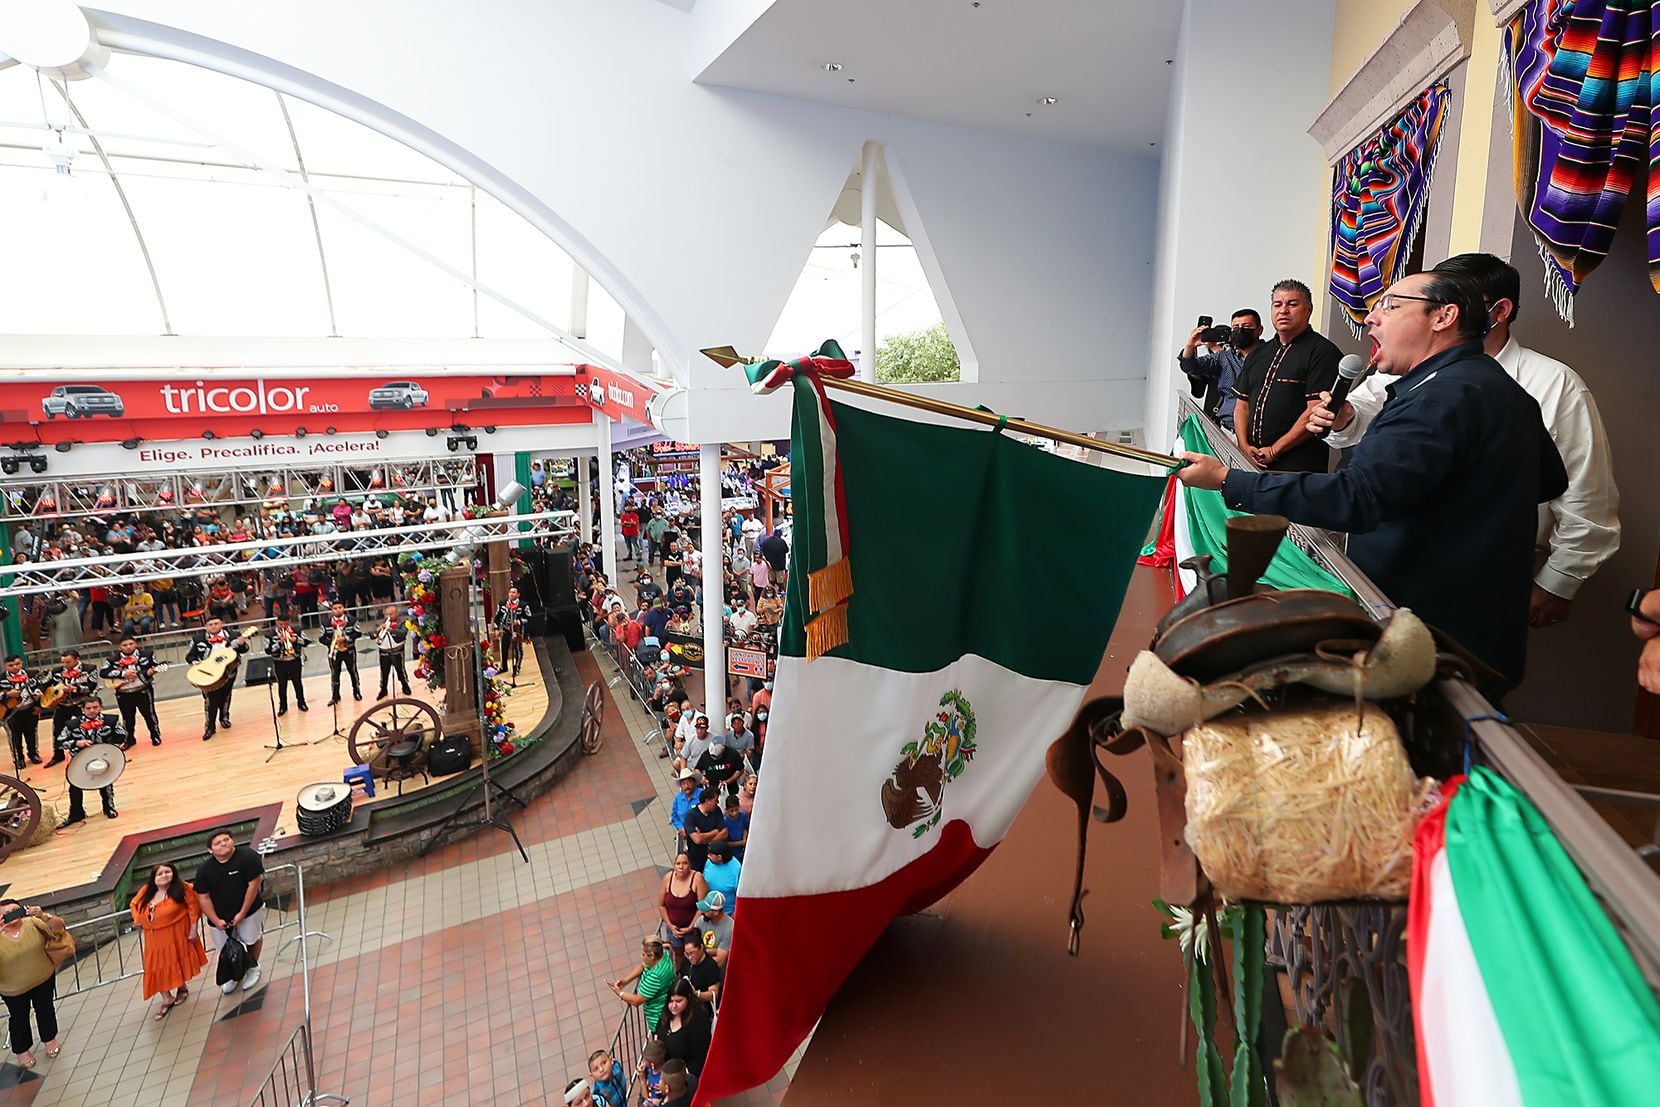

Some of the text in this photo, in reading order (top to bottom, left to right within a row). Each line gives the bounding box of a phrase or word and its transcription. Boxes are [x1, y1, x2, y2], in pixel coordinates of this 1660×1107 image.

[160, 379, 339, 414] tricolor auto
[140, 440, 380, 463] Elige. Precalifica. ¡Acelera!
